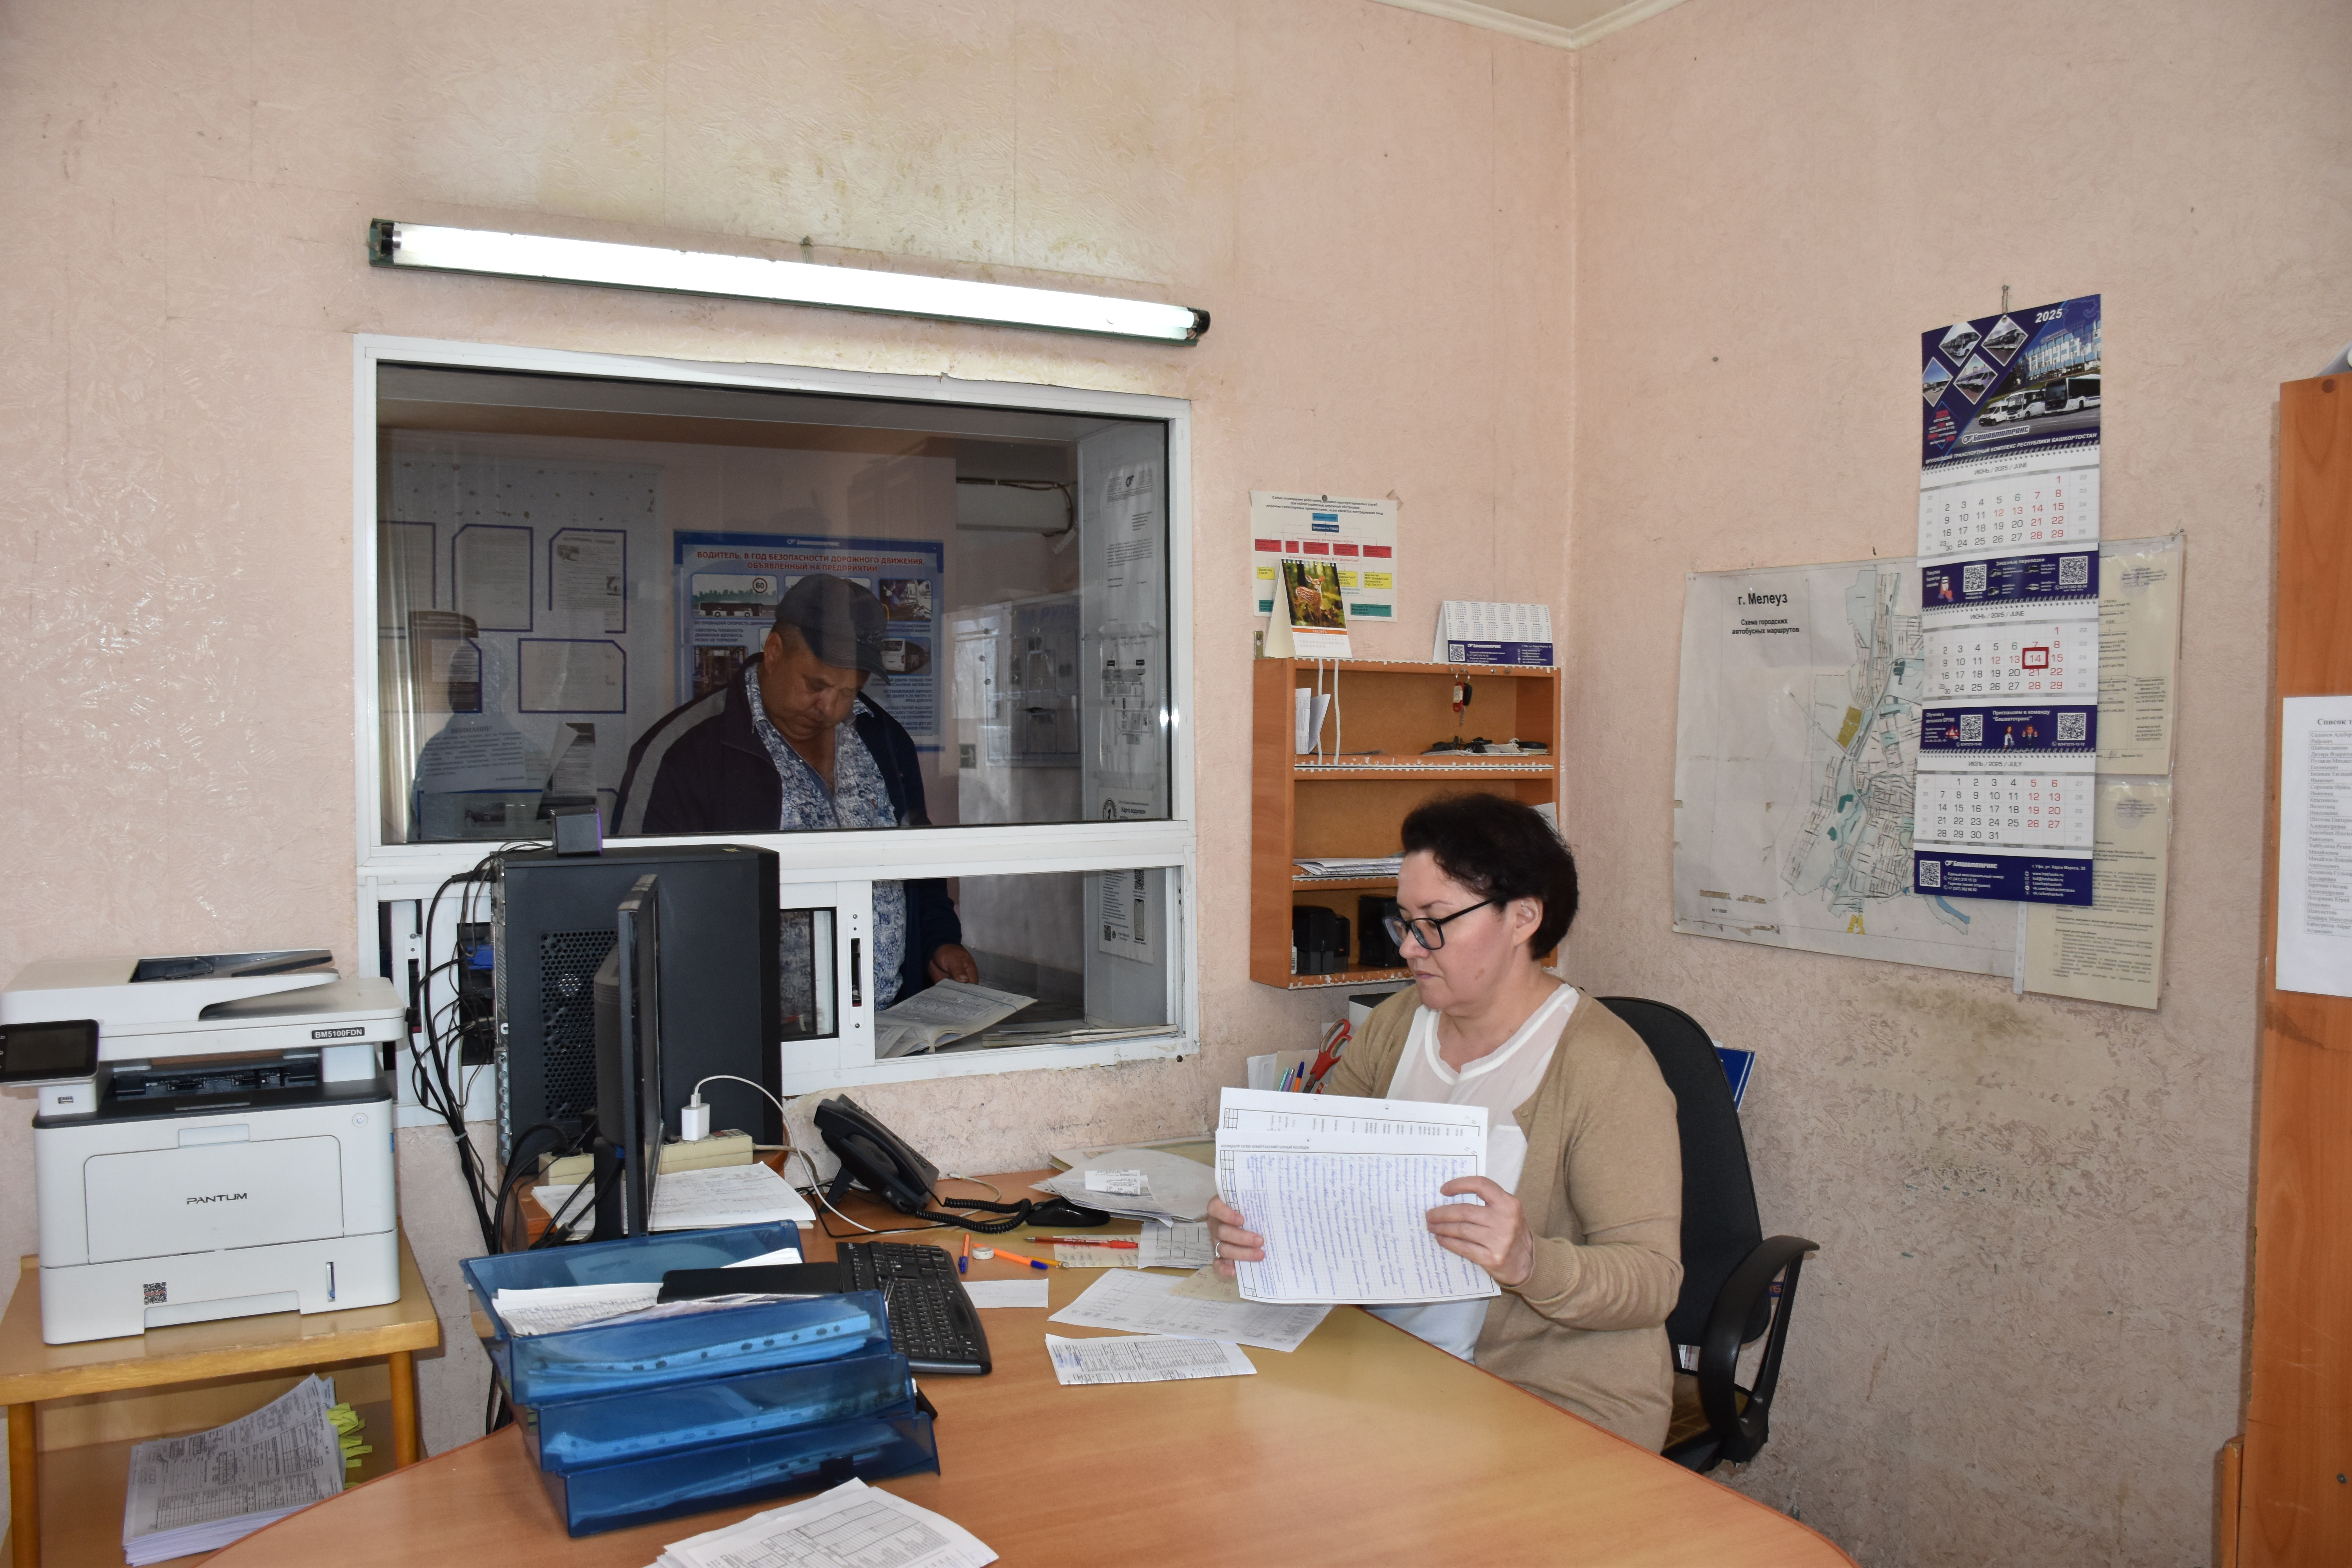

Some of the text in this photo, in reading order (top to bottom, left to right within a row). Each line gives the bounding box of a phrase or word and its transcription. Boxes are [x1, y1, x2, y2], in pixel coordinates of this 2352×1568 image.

[2035, 309, 2063, 323] 2025
[1973, 426, 2029, 442] Башавтотранс
[1926, 433, 2097, 464] КРУПНЕЙШИЙ ТРАНСПОРТНЫЙ КОМПЛЕКС РЕСПУБЛИКИ БАШКОРТОСТАН
[2052, 516, 2063, 524] 22
[2031, 532, 2042, 540] 28
[2051, 530, 2063, 538] 29
[697, 551, 742, 560] ВОДИТЕЛЬ,
[769, 553, 829, 562] БЕЗОПАСНОСТИ
[831, 555, 879, 564] ДОРОЖНОГО
[881, 557, 925, 566] ДВИЖЕНИЯ,
[747, 562, 808, 571] ОБЪЯВЛЕННЫЙ
[1738, 593, 1788, 606] г. Мелеуз
[451, 726, 493, 734] ВНИМАНИЕ!
[1953, 860, 1998, 869] Башавтотранс
[314, 1028, 362, 1038] BM5100FDN
[186, 1192, 247, 1205] PANTUM
